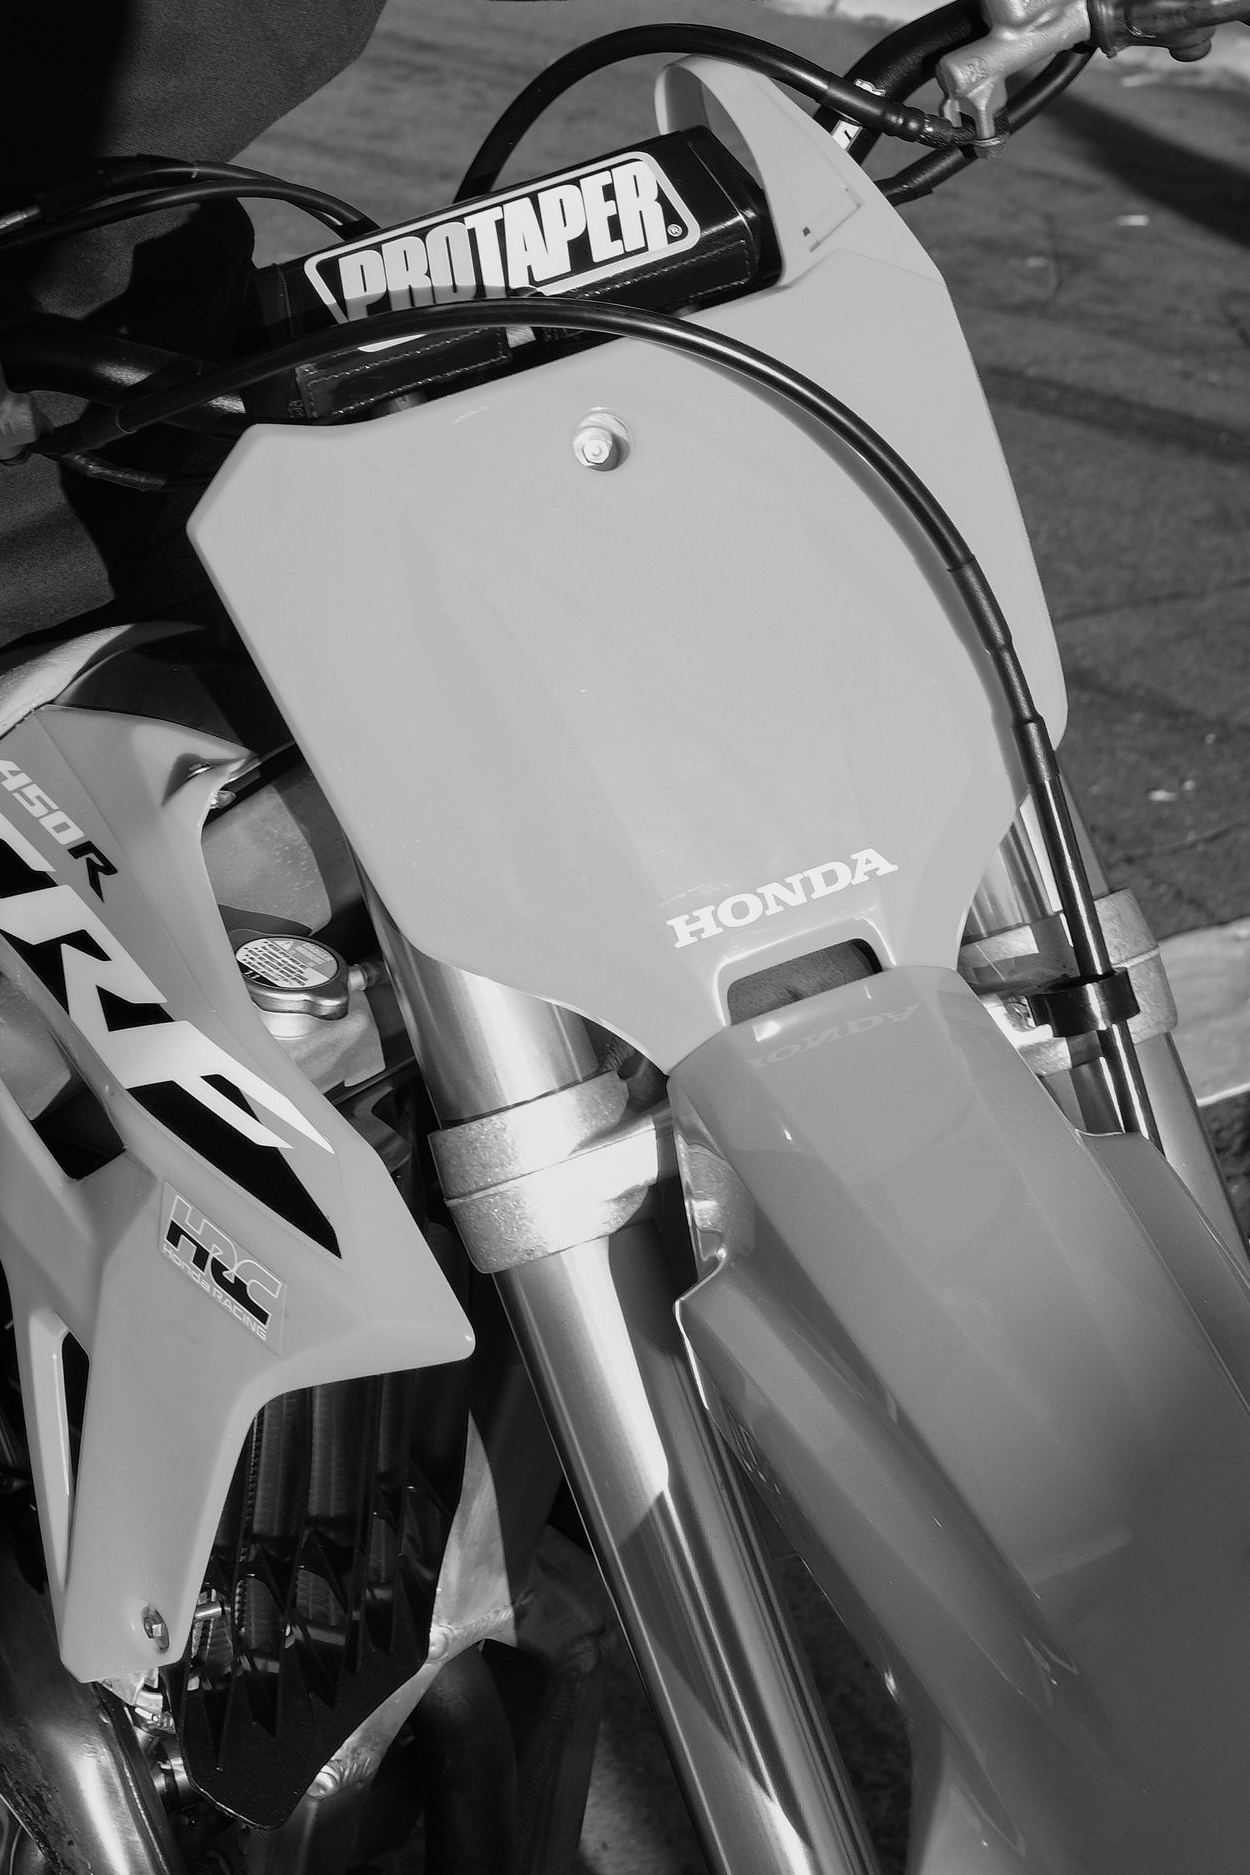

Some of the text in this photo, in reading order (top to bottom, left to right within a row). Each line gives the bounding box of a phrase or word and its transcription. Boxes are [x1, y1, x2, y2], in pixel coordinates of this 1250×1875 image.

[338, 159, 668, 320] PROTAPER
[666, 847, 899, 948] HONDA
[162, 1243, 268, 1342] Honda RACING
[164, 1194, 283, 1329] HRC
